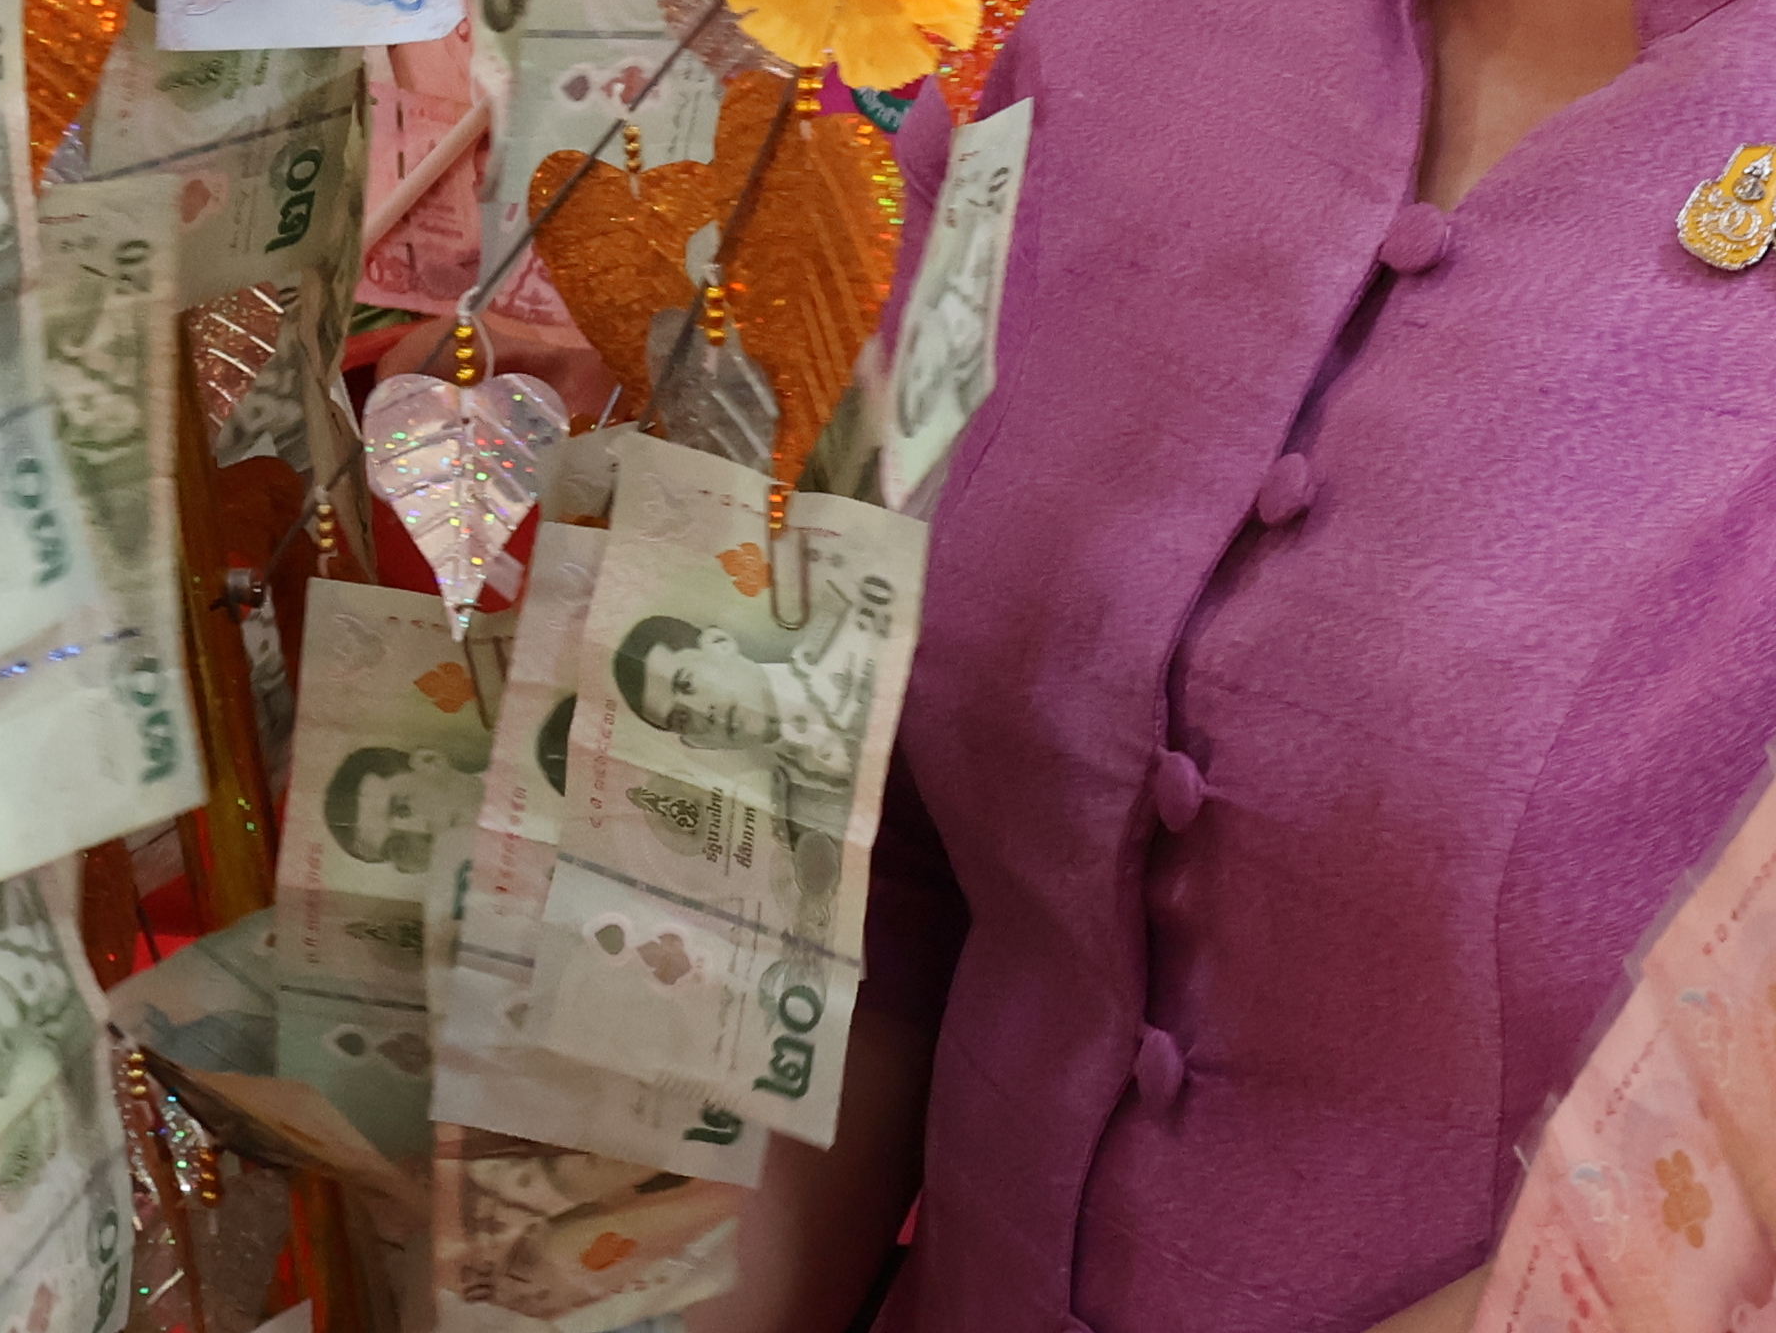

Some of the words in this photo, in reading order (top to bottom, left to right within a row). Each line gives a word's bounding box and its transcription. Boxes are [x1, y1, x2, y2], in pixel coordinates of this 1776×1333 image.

[265, 147, 323, 254] ๒๐
[855, 576, 897, 640] 20
[751, 984, 824, 1101] ๒๐
